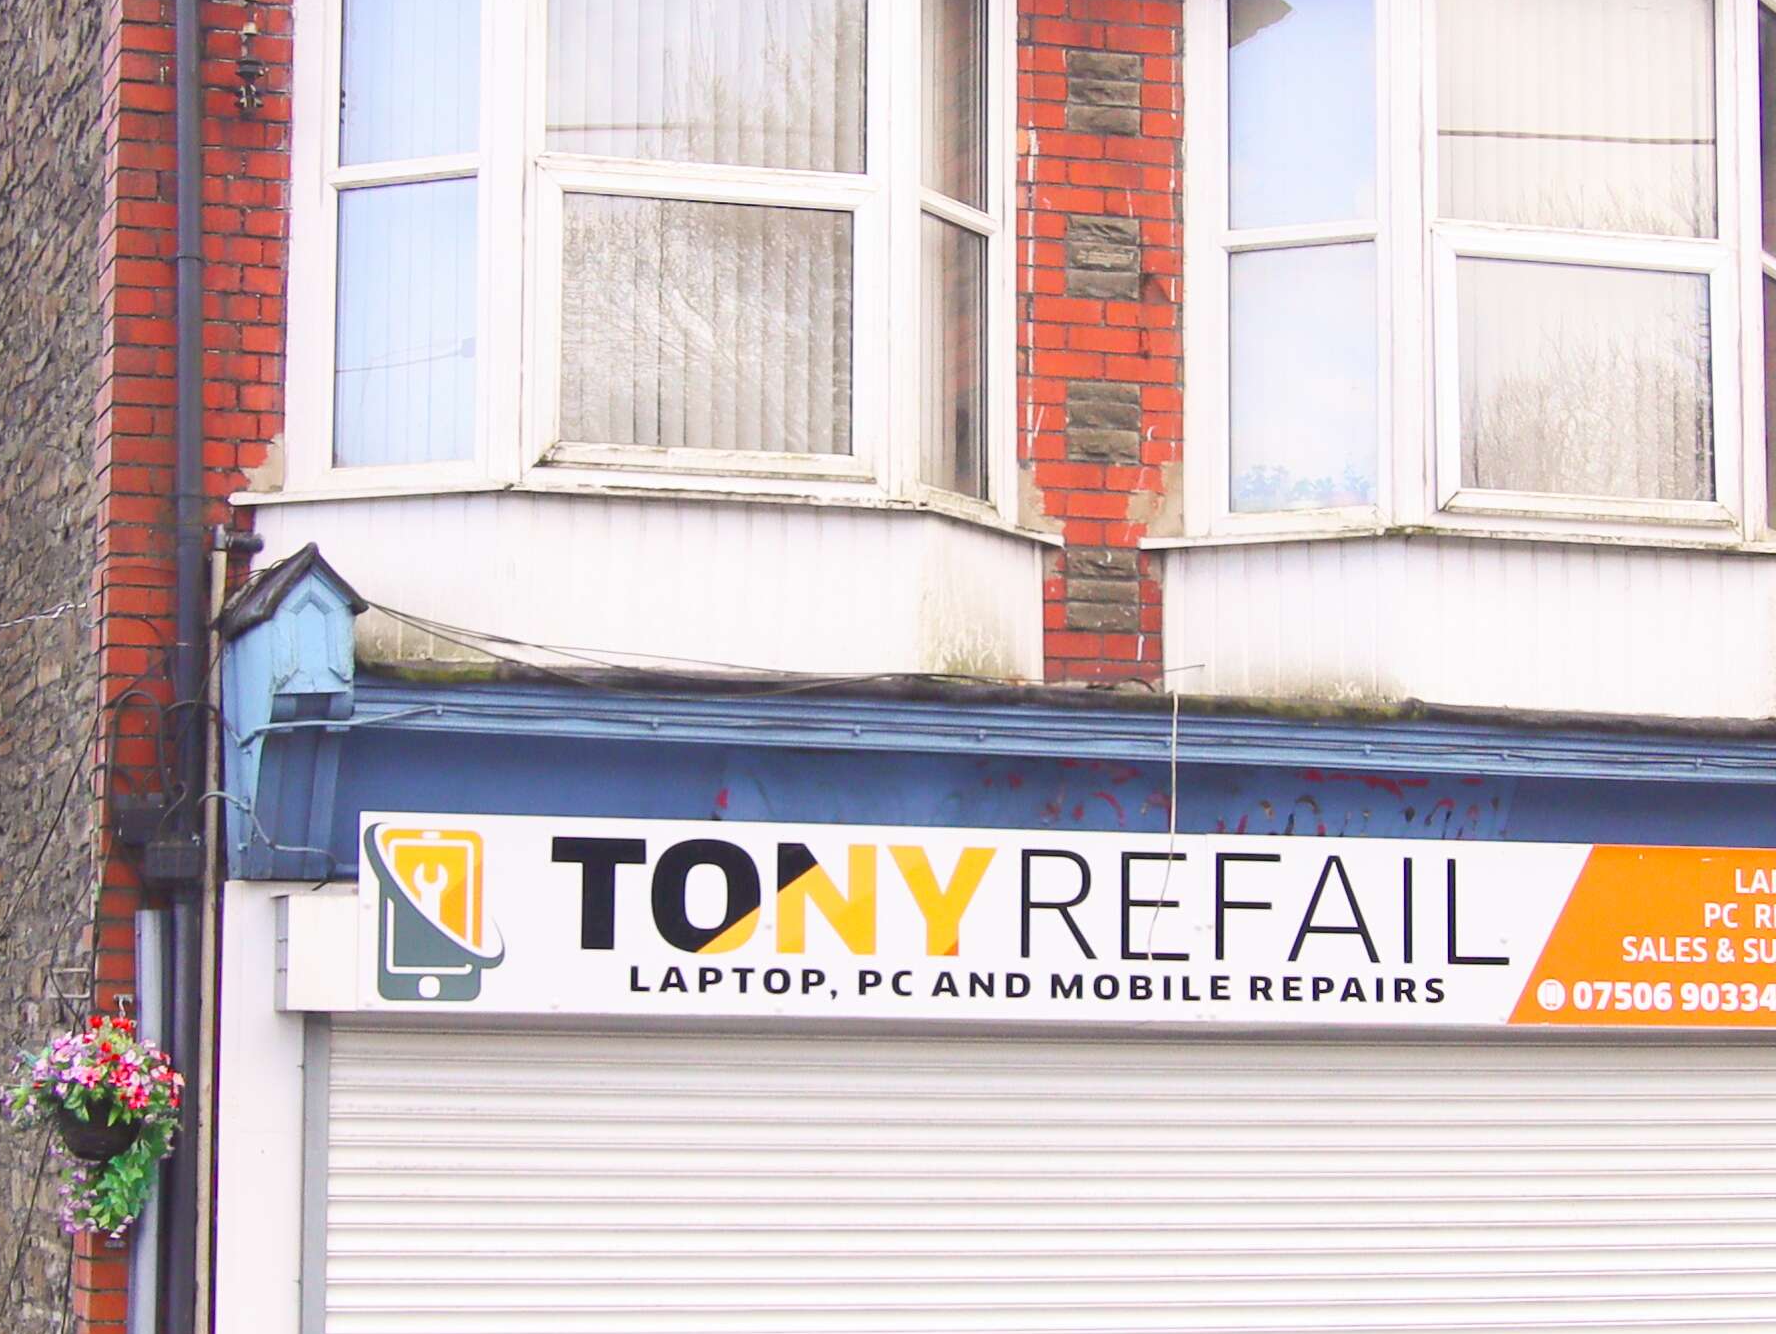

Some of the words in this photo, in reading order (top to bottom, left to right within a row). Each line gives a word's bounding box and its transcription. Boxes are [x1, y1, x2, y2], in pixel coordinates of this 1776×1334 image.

[1704, 902, 1739, 929] PC
[1622, 935, 1708, 963] SALES
[1716, 937, 1736, 964] &
[629, 966, 838, 1000] LAPTOP,
[858, 970, 914, 998] PC
[932, 972, 1031, 999] AND
[1050, 974, 1233, 1002] MOBILE
[1250, 976, 1446, 1004] REPAIRS
[1572, 981, 1674, 1011] 07506
